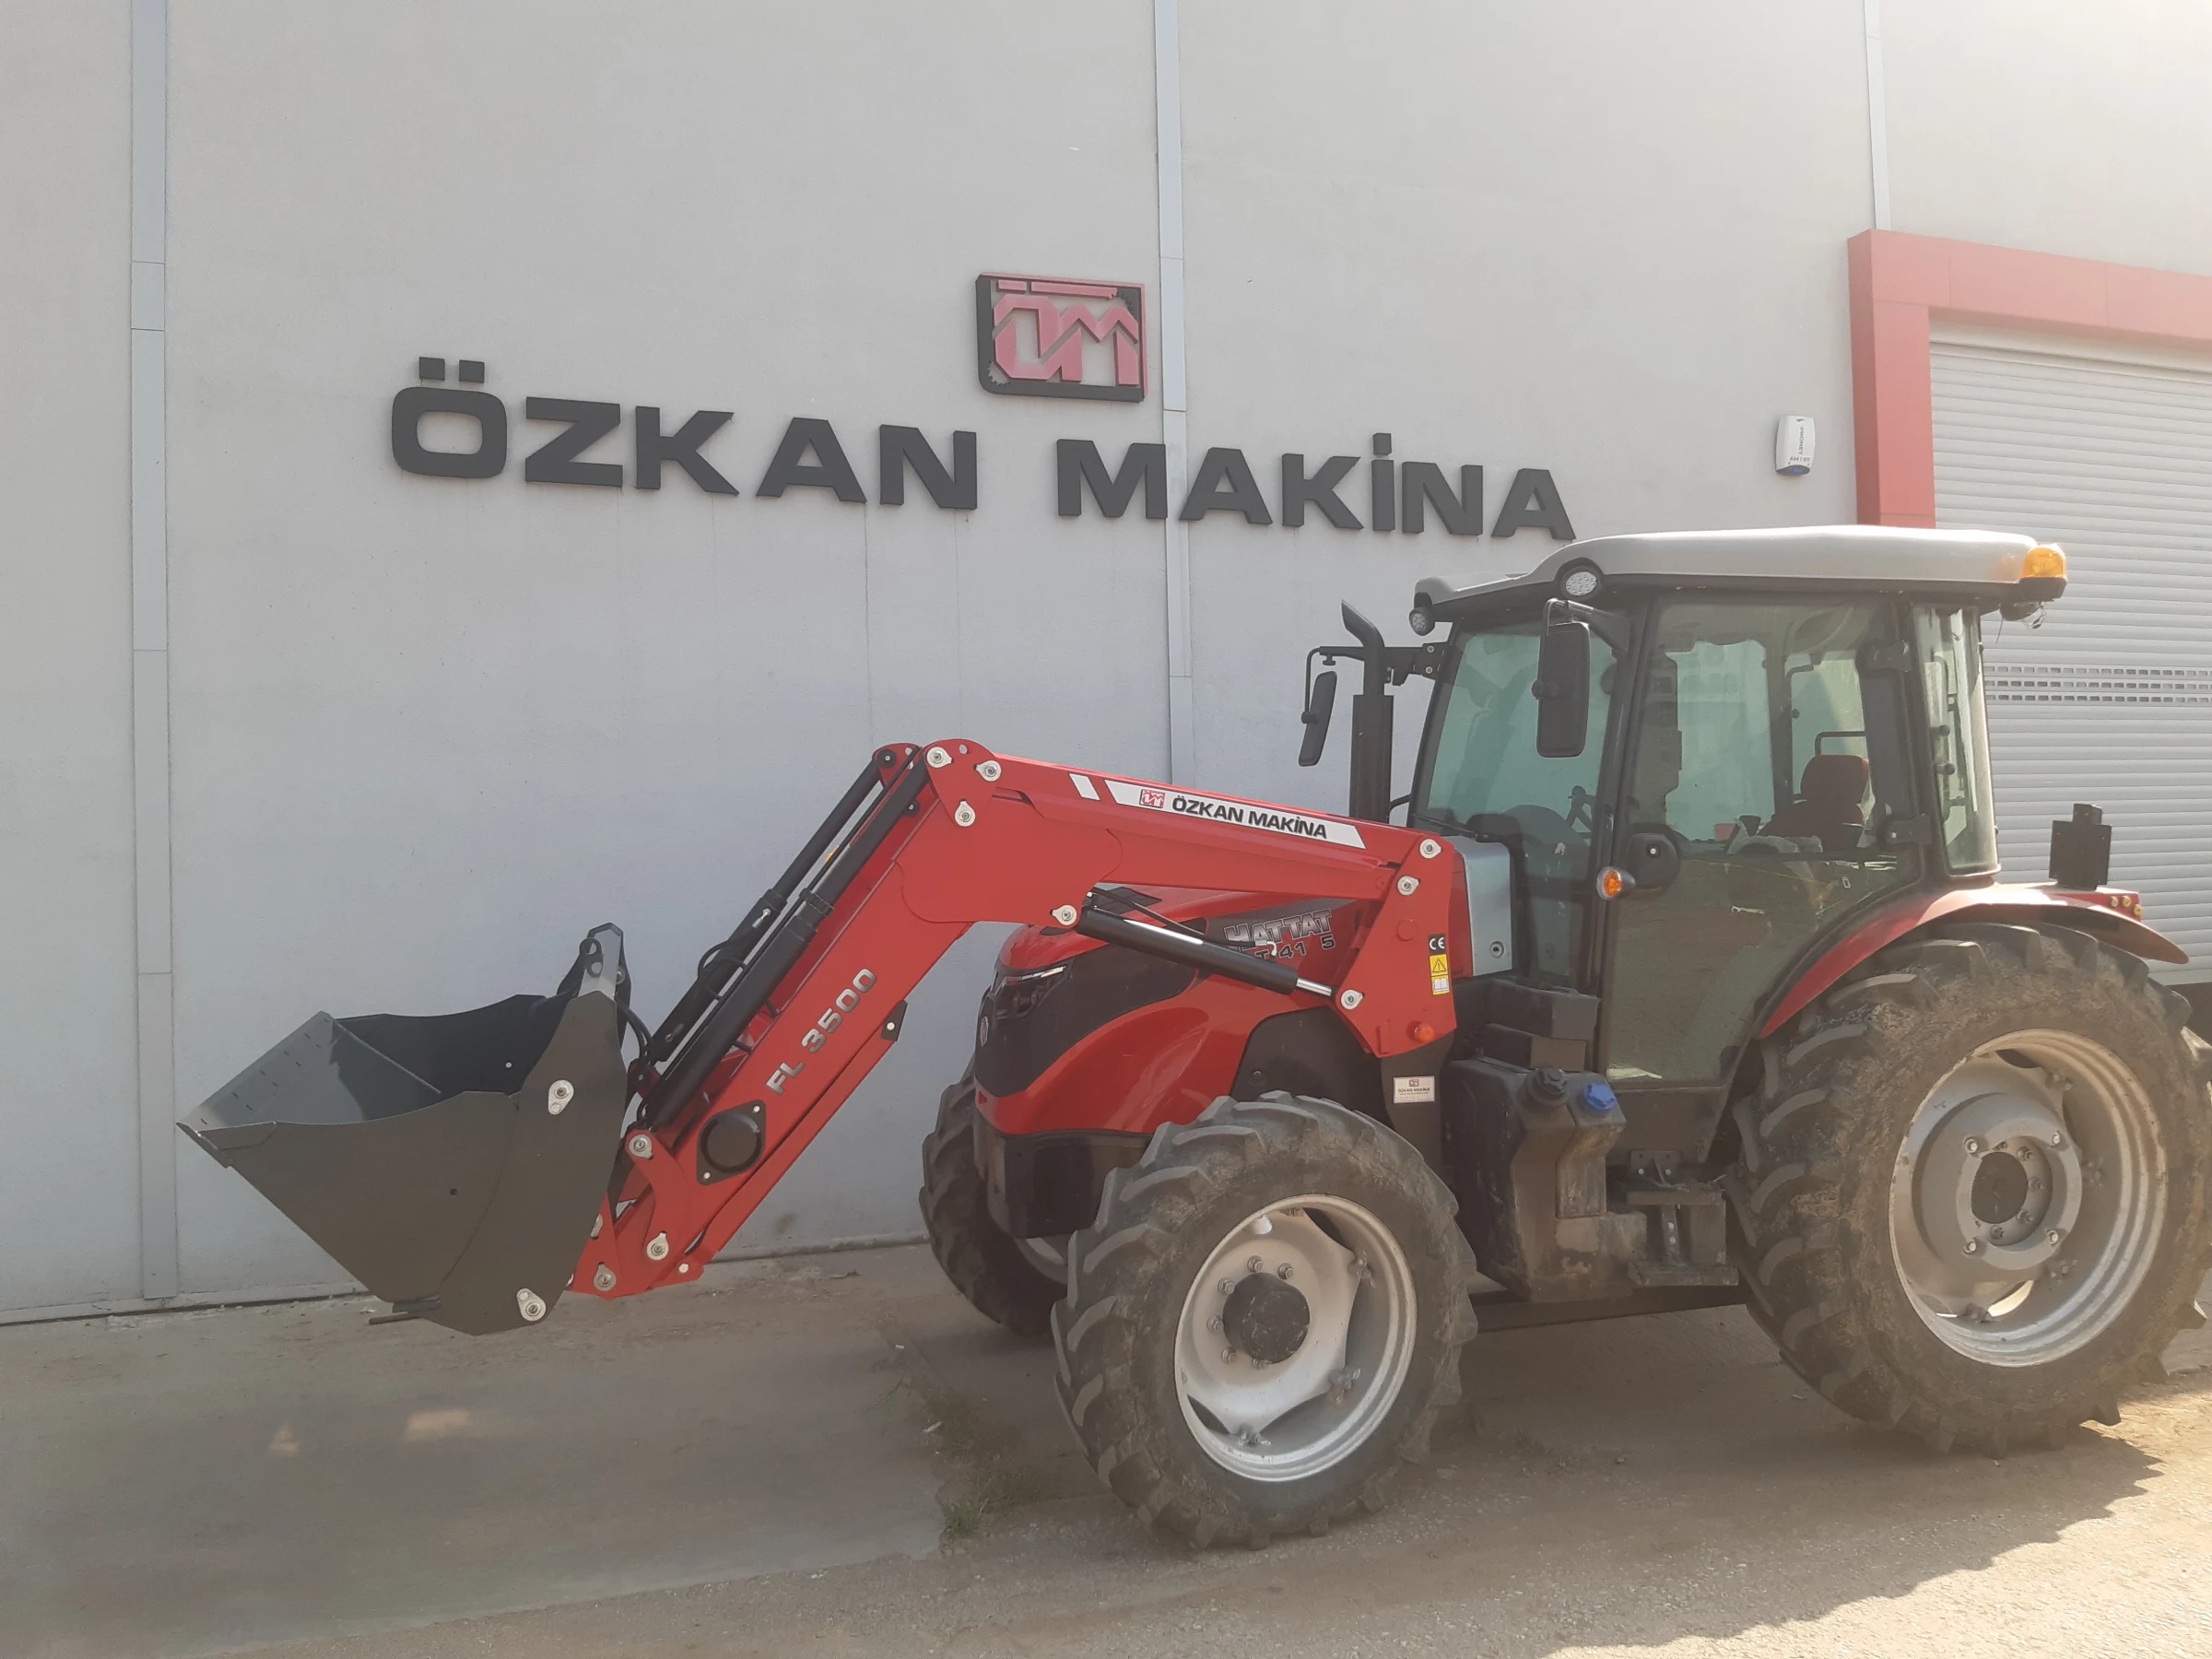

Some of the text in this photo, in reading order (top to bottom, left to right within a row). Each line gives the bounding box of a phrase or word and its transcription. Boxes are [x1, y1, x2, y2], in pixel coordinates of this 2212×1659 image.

[391, 356, 1577, 541] ÖZKAN MAKİNA
[1171, 795, 1328, 840] ÖZKAN MAKİNA
[1223, 908, 1333, 951] HATTAT
[765, 968, 877, 1096] FL 3500
